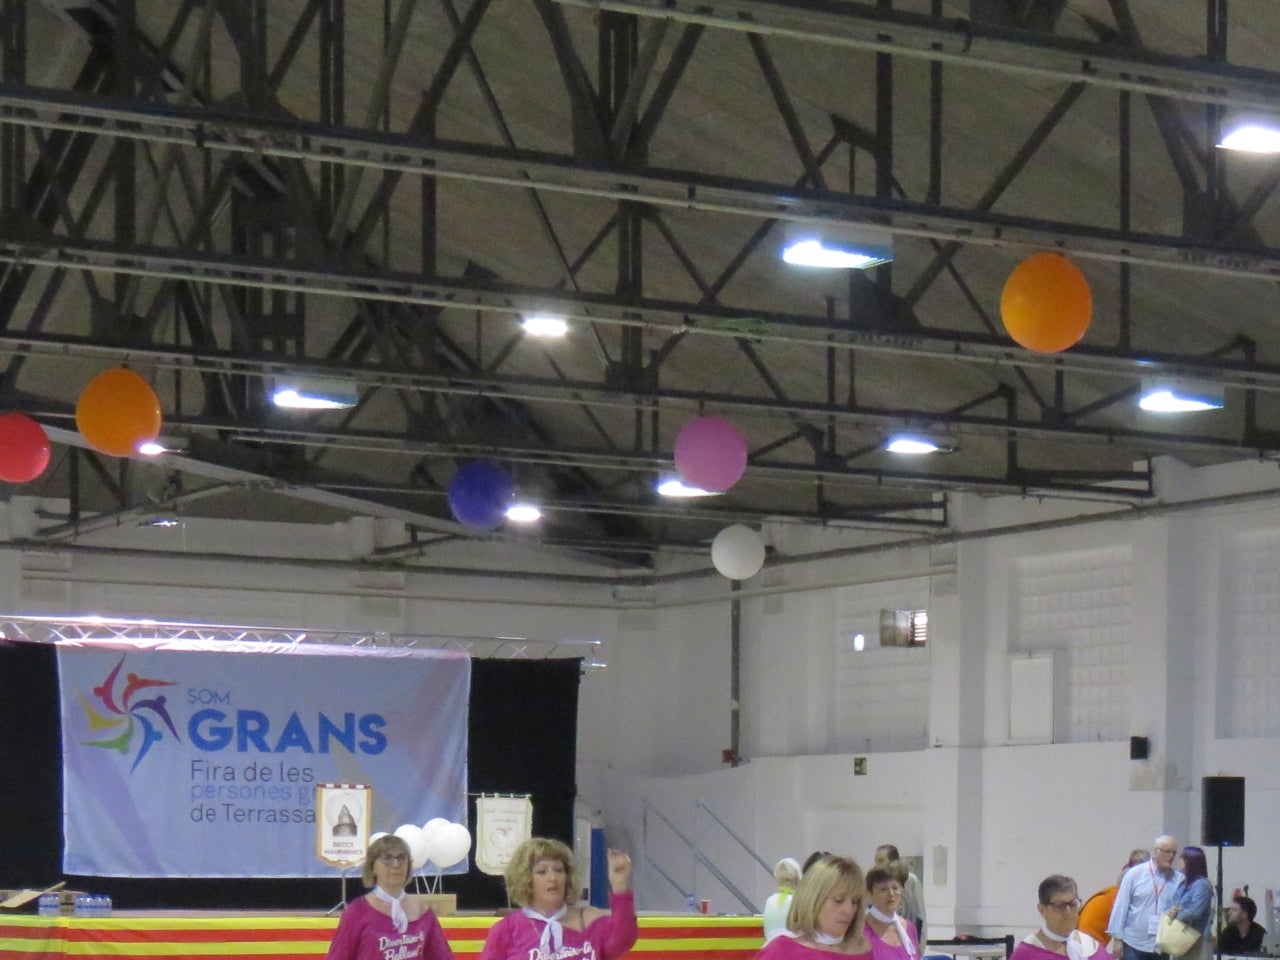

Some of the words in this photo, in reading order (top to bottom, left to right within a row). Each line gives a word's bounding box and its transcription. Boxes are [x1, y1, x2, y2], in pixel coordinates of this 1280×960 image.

[187, 688, 231, 704] SOM
[187, 708, 388, 755] GRANS
[190, 760, 236, 781] Fira
[243, 762, 273, 783] de
[279, 763, 314, 783] les
[191, 784, 292, 804] persones
[190, 804, 217, 822] de
[221, 803, 317, 824] Terrassa
